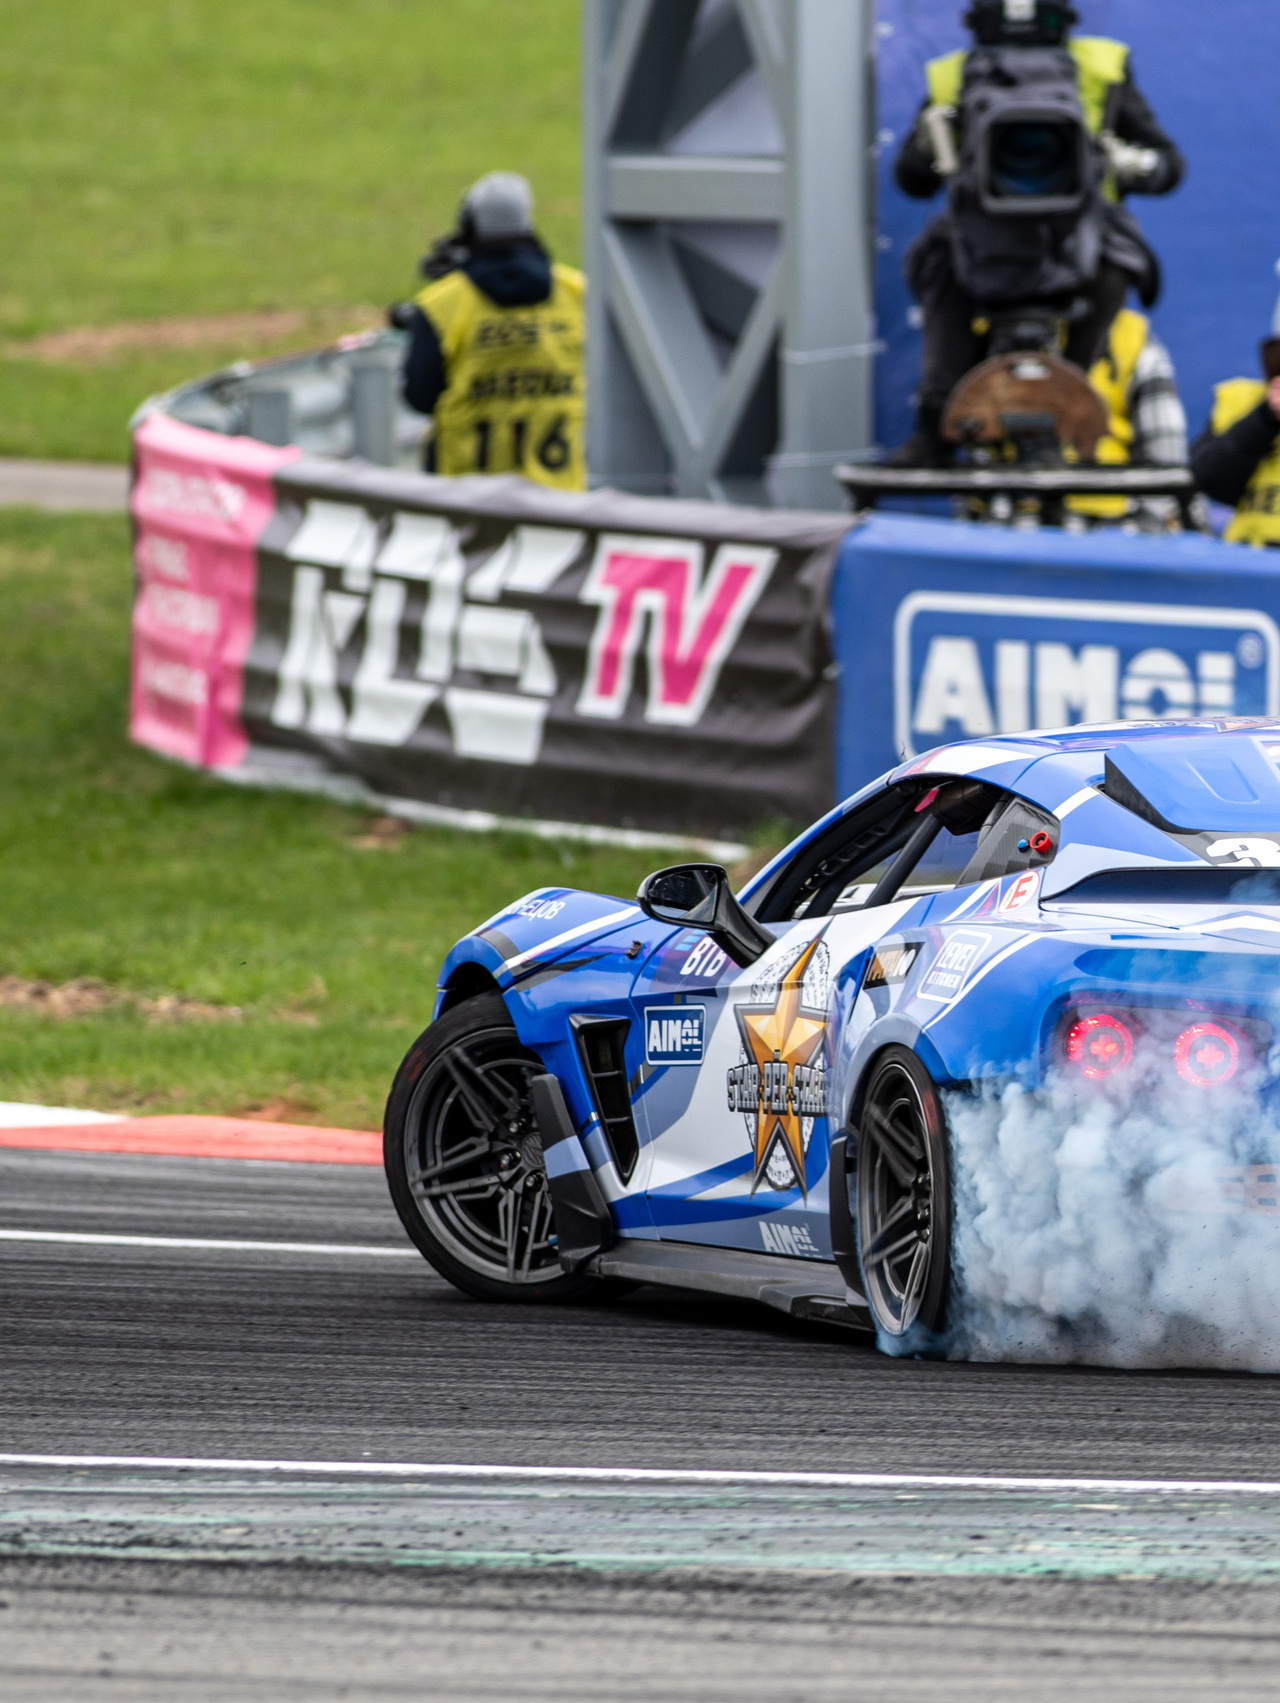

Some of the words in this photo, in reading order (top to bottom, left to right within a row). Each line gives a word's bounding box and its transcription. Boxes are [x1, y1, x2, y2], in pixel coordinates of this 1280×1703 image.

[475, 412, 571, 472] 116
[577, 532, 778, 727] TV
[914, 636, 1236, 736] AIMOL
[936, 941, 979, 972] LEVEL
[926, 970, 963, 989] KITCHEN
[648, 1019, 702, 1052] AIMOL
[758, 1220, 823, 1258] AIMOL
